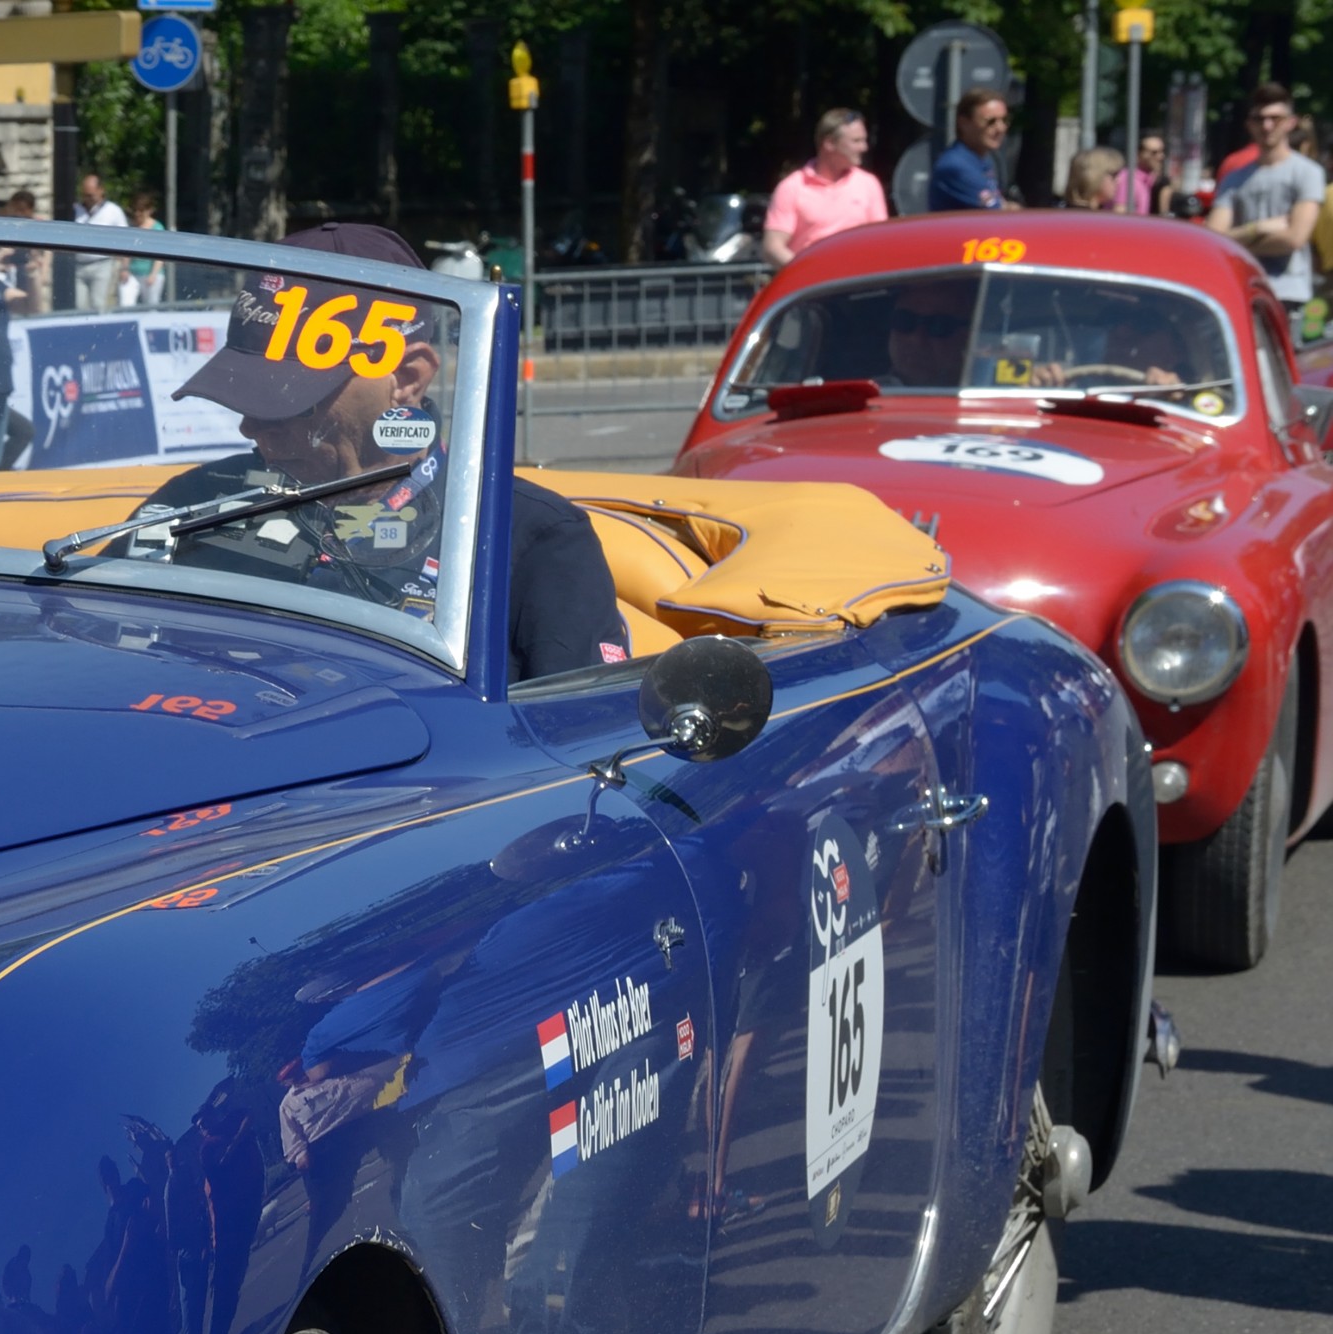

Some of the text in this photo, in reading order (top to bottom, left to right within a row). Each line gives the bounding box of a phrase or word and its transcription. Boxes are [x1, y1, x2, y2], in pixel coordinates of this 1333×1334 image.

[962, 237, 1027, 265] 169
[264, 285, 417, 379] 165
[379, 426, 430, 438] VERIFICATO
[942, 444, 1044, 462] 169
[379, 527, 398, 540] 38
[567, 976, 653, 1073] Pilot Klaas de Boer
[827, 957, 866, 1117] 165
[579, 1057, 660, 1162] Co-Pilot Ton Koolen
